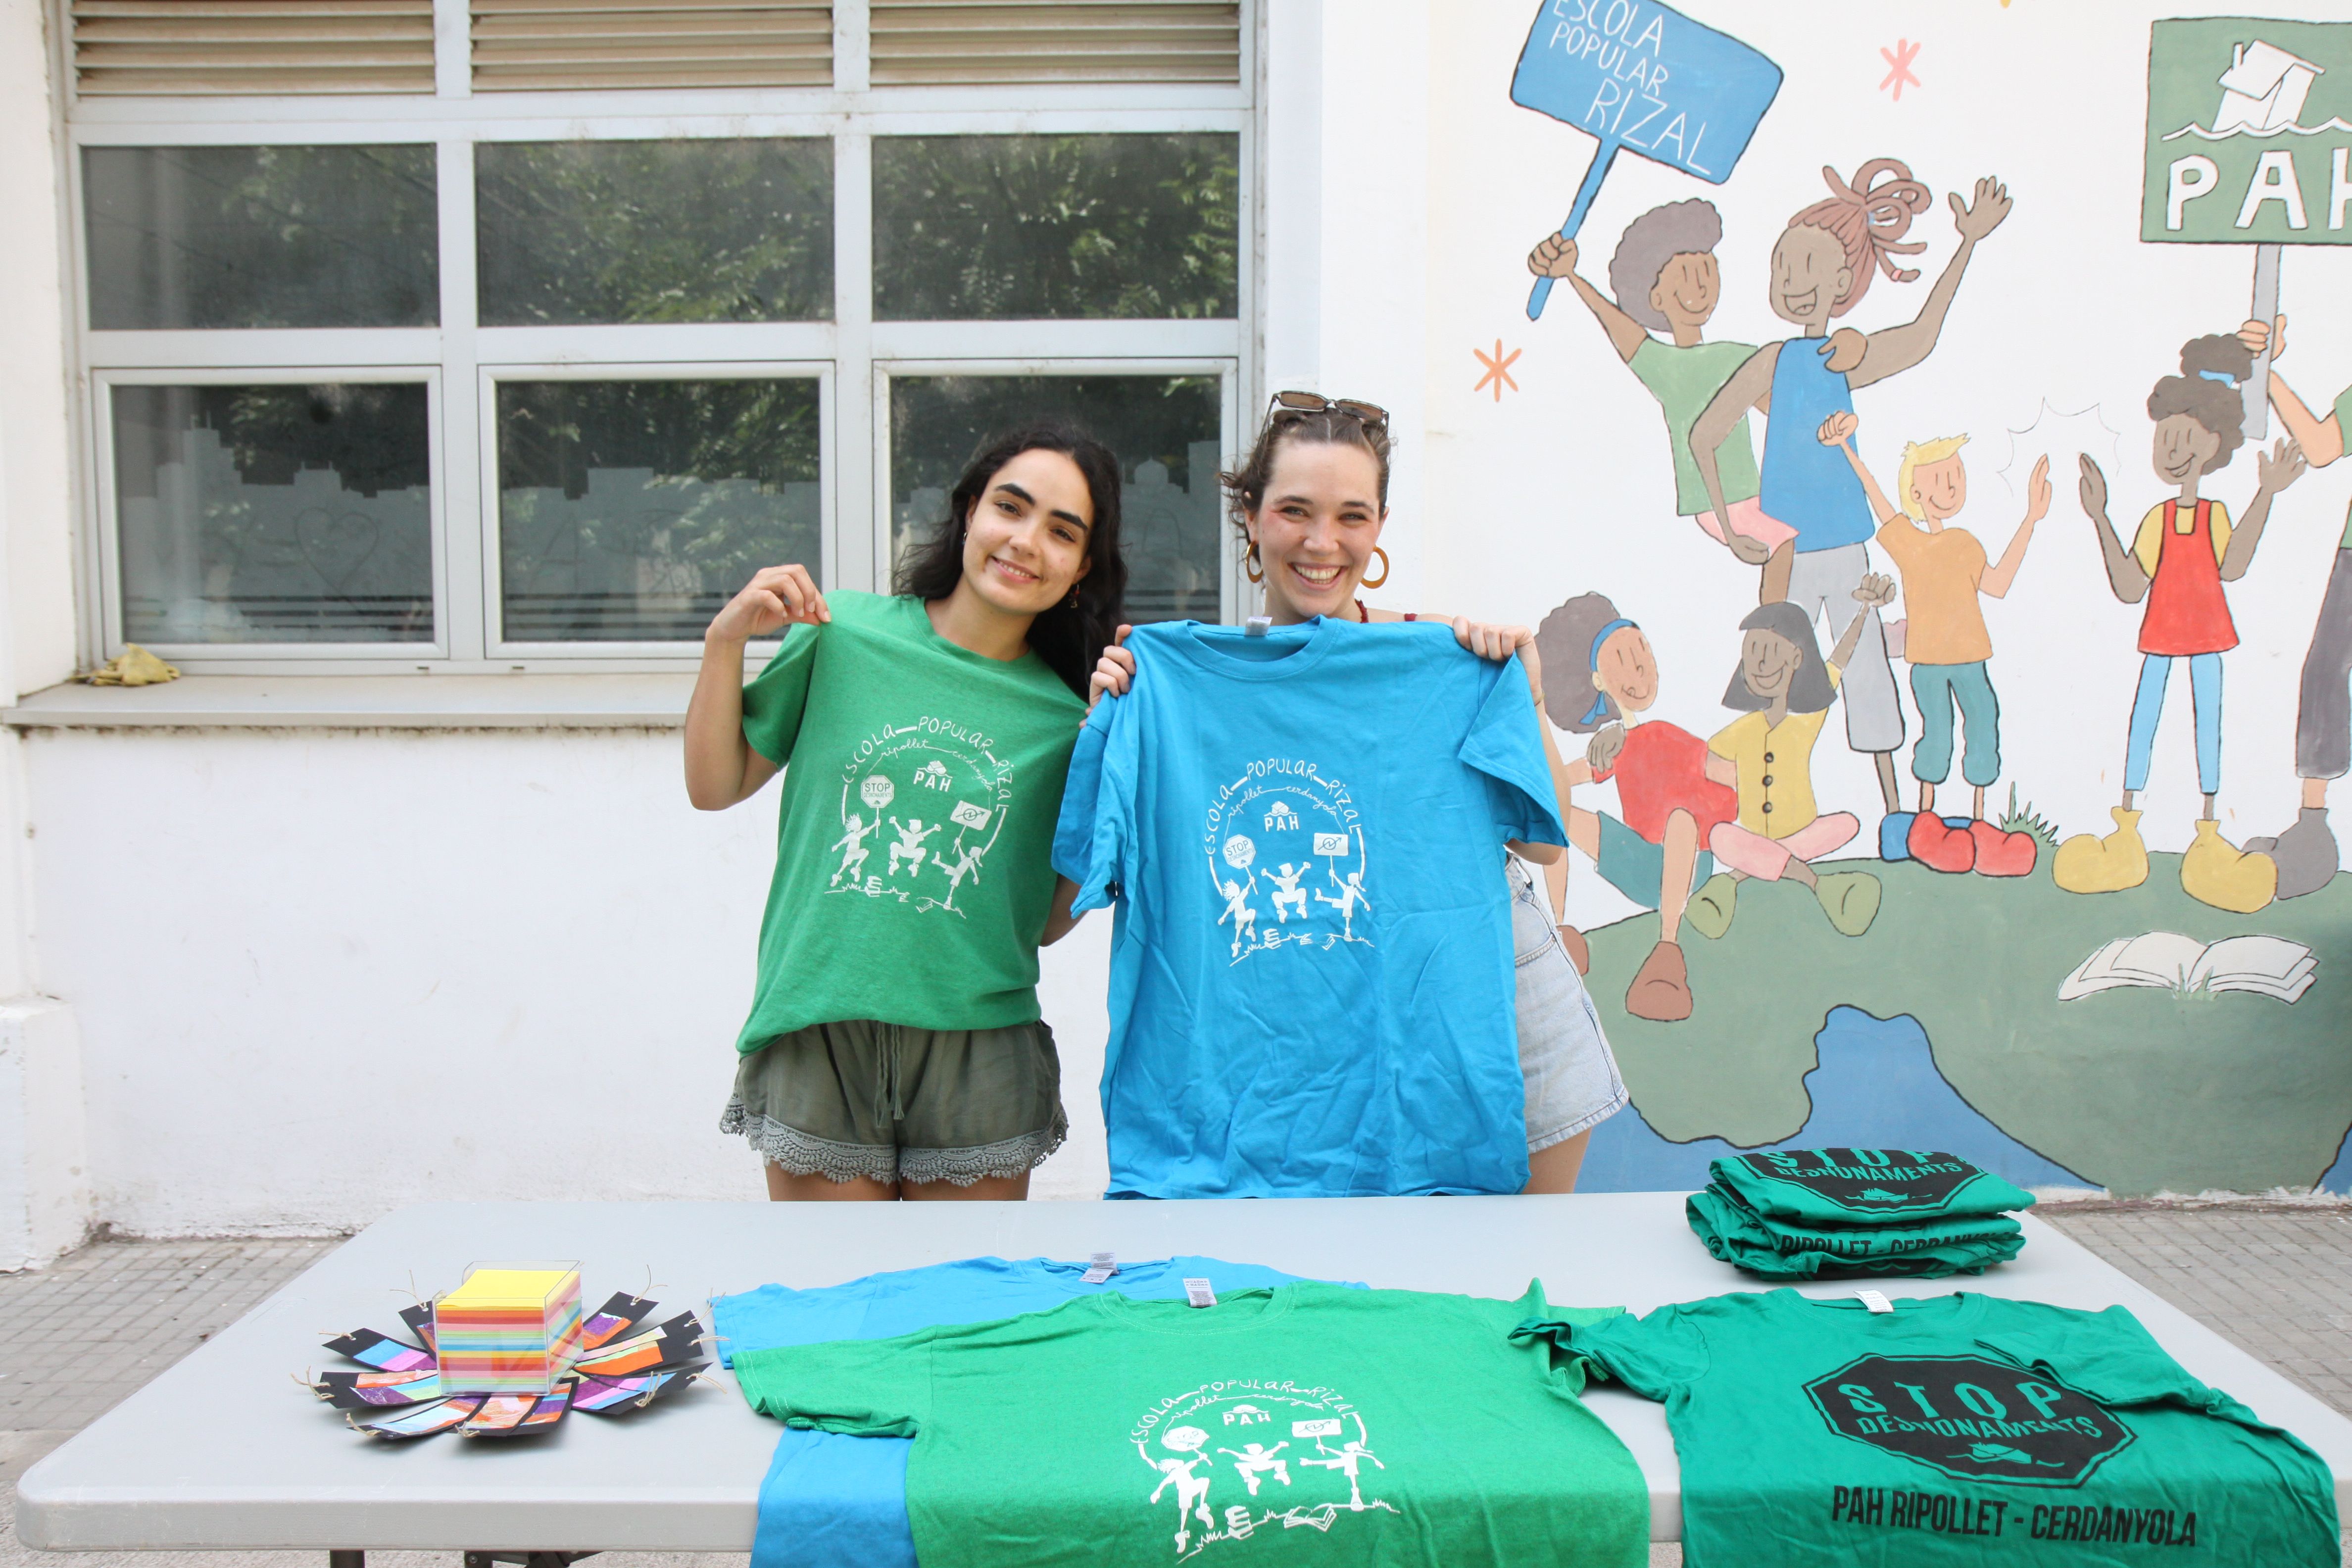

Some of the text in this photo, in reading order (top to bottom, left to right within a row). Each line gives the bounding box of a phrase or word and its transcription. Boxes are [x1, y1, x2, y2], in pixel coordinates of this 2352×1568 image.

[1549, 21, 1668, 97] POPULAR
[1585, 78, 1711, 175] RIZAL
[865, 783, 890, 792] STOP
[913, 771, 952, 792] PAH
[1264, 815, 1299, 832] PAH
[1226, 840, 1248, 856] STOP
[1838, 1381, 2061, 1420] STOP
[1223, 1414, 1271, 1425] PAH
[1832, 1485, 1882, 1526] PAH
[1890, 1489, 2009, 1537] RIPOLLET
[2031, 1504, 2197, 1547] CERDANYOLA
